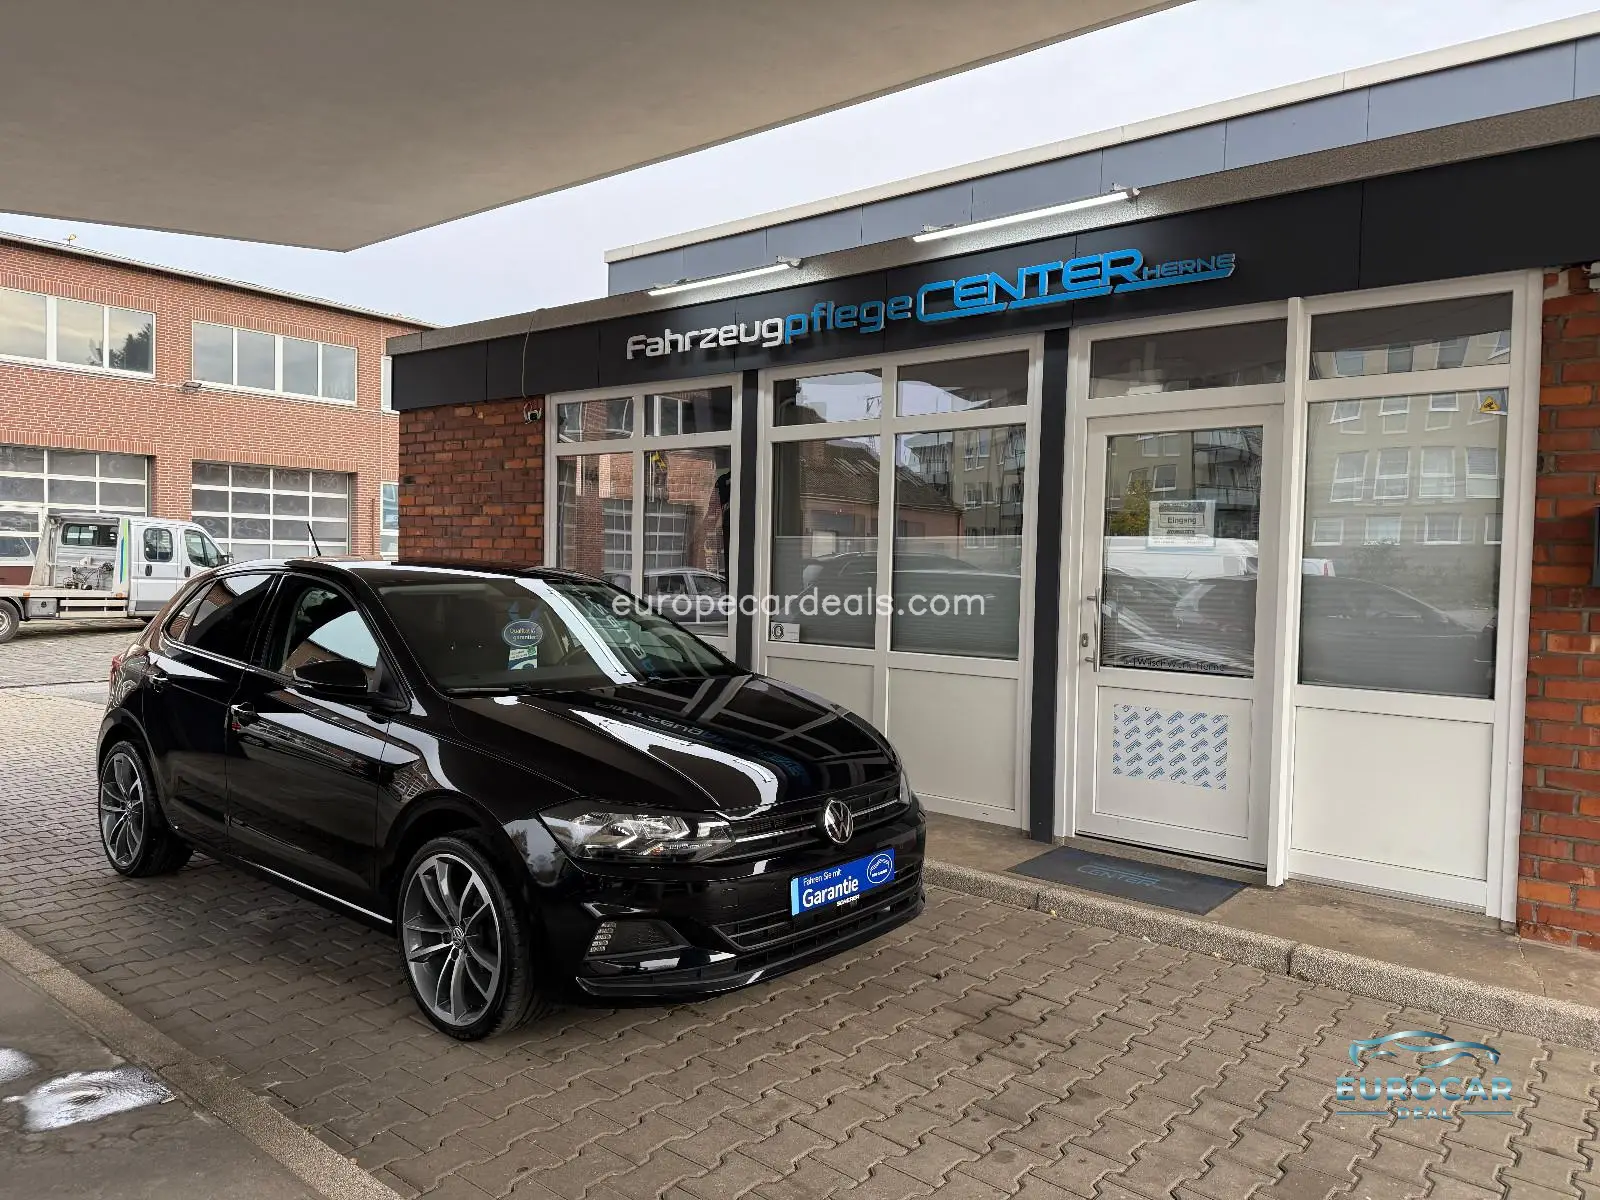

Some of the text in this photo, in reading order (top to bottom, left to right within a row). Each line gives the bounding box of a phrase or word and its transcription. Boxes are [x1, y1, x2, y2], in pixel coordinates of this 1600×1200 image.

[1142, 253, 1235, 280] HERNE
[803, 867, 842, 887] Fahren Sie mit
[802, 875, 859, 908] Garantie
